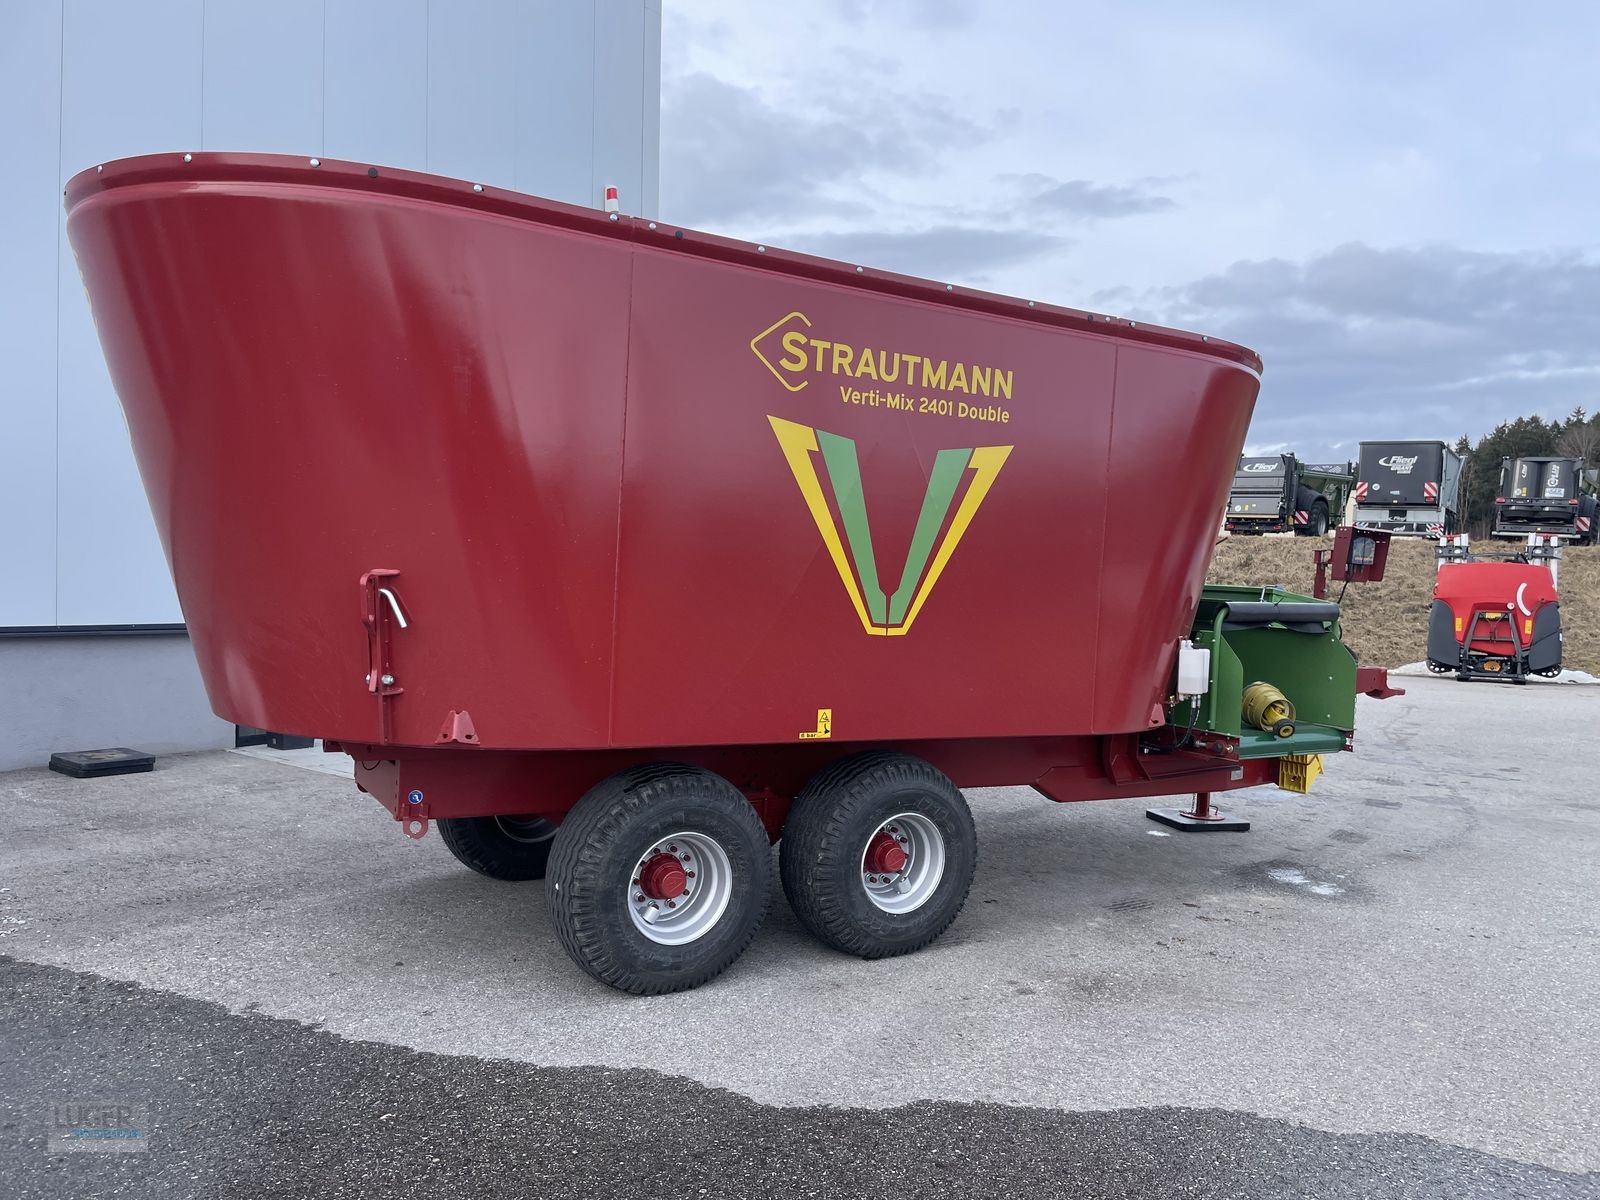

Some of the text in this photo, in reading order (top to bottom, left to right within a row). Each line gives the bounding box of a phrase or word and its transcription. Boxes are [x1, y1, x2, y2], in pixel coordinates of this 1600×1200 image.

[778, 331, 1014, 400] STRAUTMANN
[840, 386, 1010, 423] Verti-Mix 2401 Double
